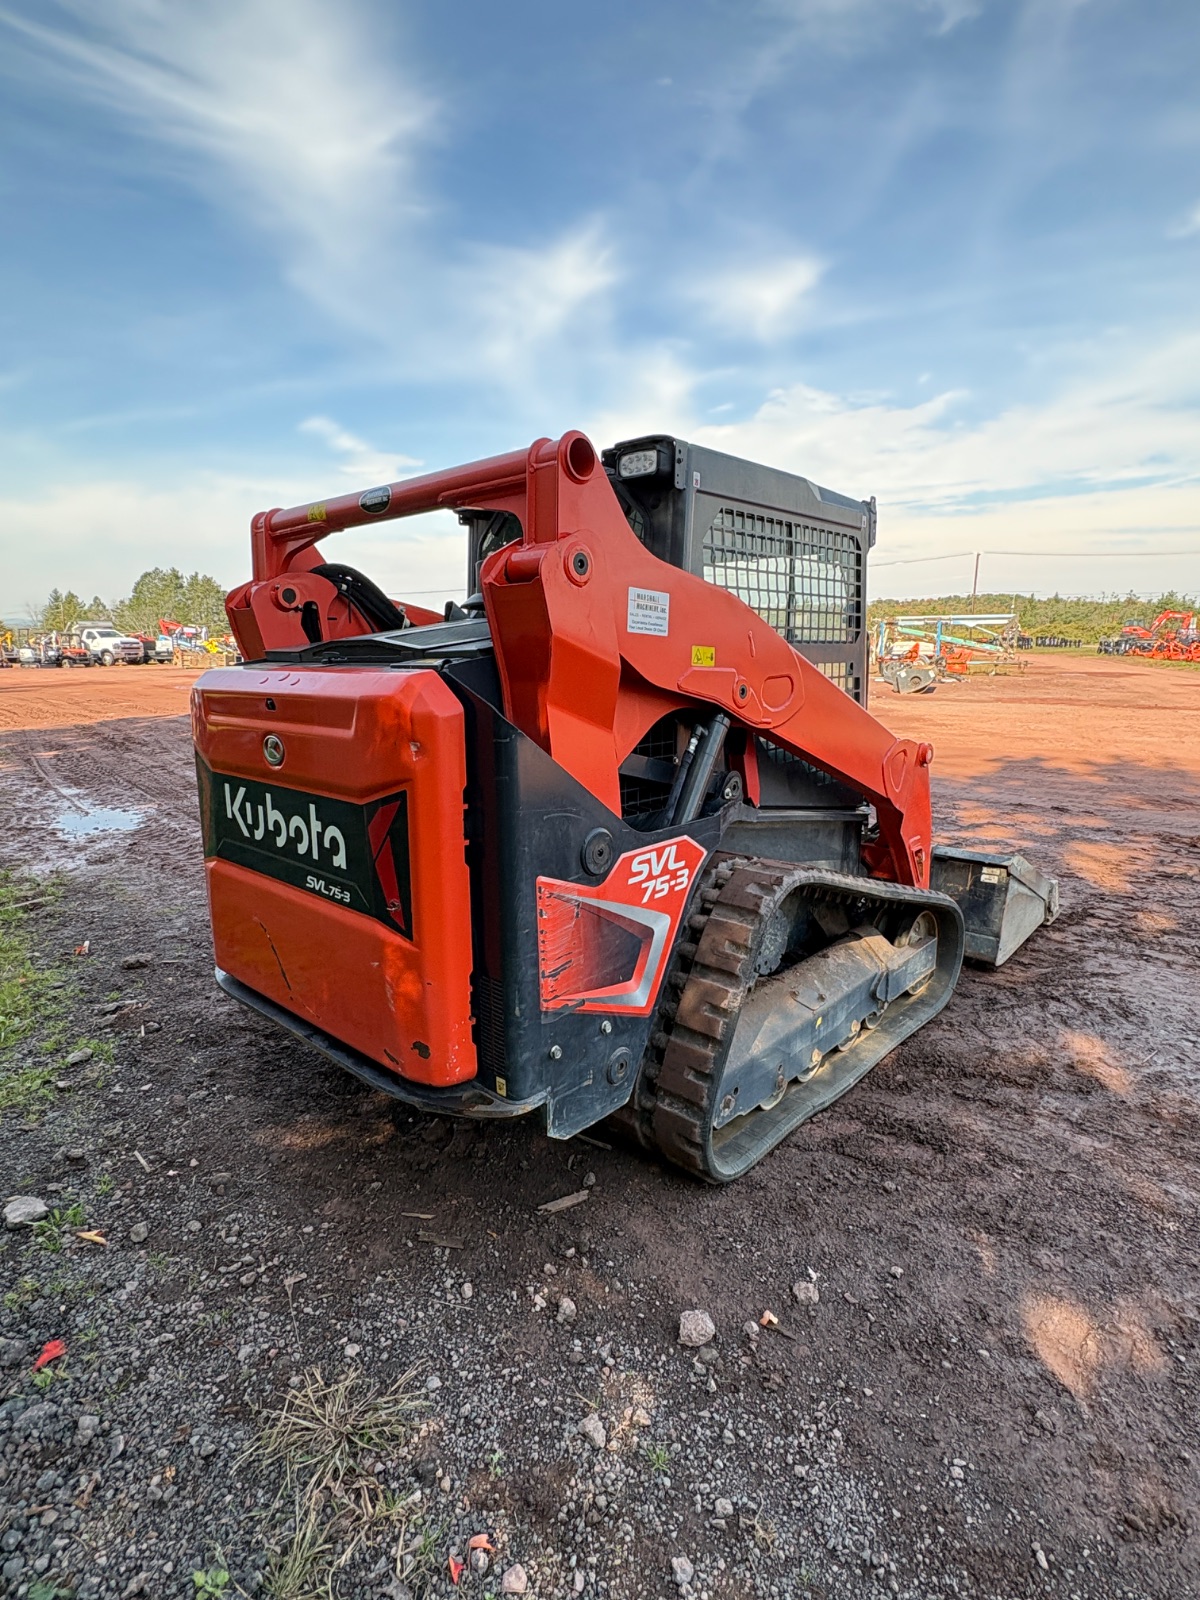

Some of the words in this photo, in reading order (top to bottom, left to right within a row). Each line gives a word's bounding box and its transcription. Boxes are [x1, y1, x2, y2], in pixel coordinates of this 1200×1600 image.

[224, 783, 347, 870] Kubota
[627, 844, 686, 885] SVL
[641, 868, 690, 904] 75-3
